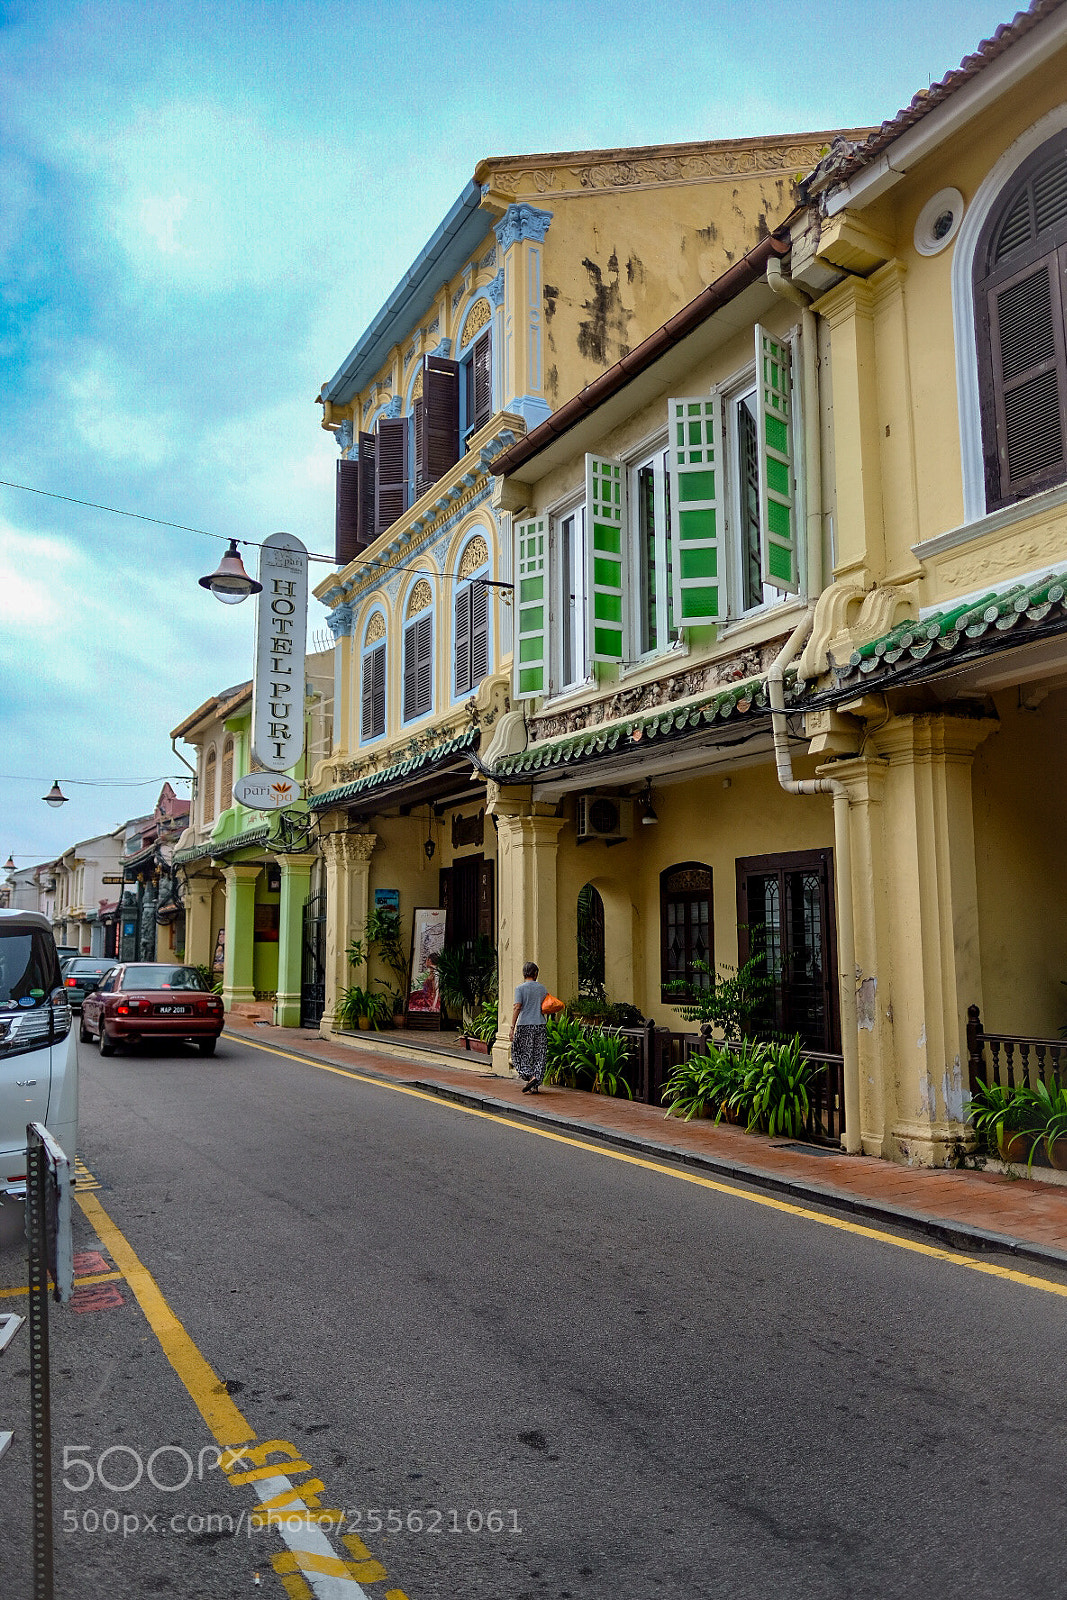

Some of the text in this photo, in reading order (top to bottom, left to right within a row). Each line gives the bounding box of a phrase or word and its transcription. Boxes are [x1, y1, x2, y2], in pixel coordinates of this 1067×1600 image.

[270, 578, 297, 674] HOTEL
[267, 682, 293, 759] PURI
[243, 785, 270, 799] puri
[270, 793, 292, 806] spa
